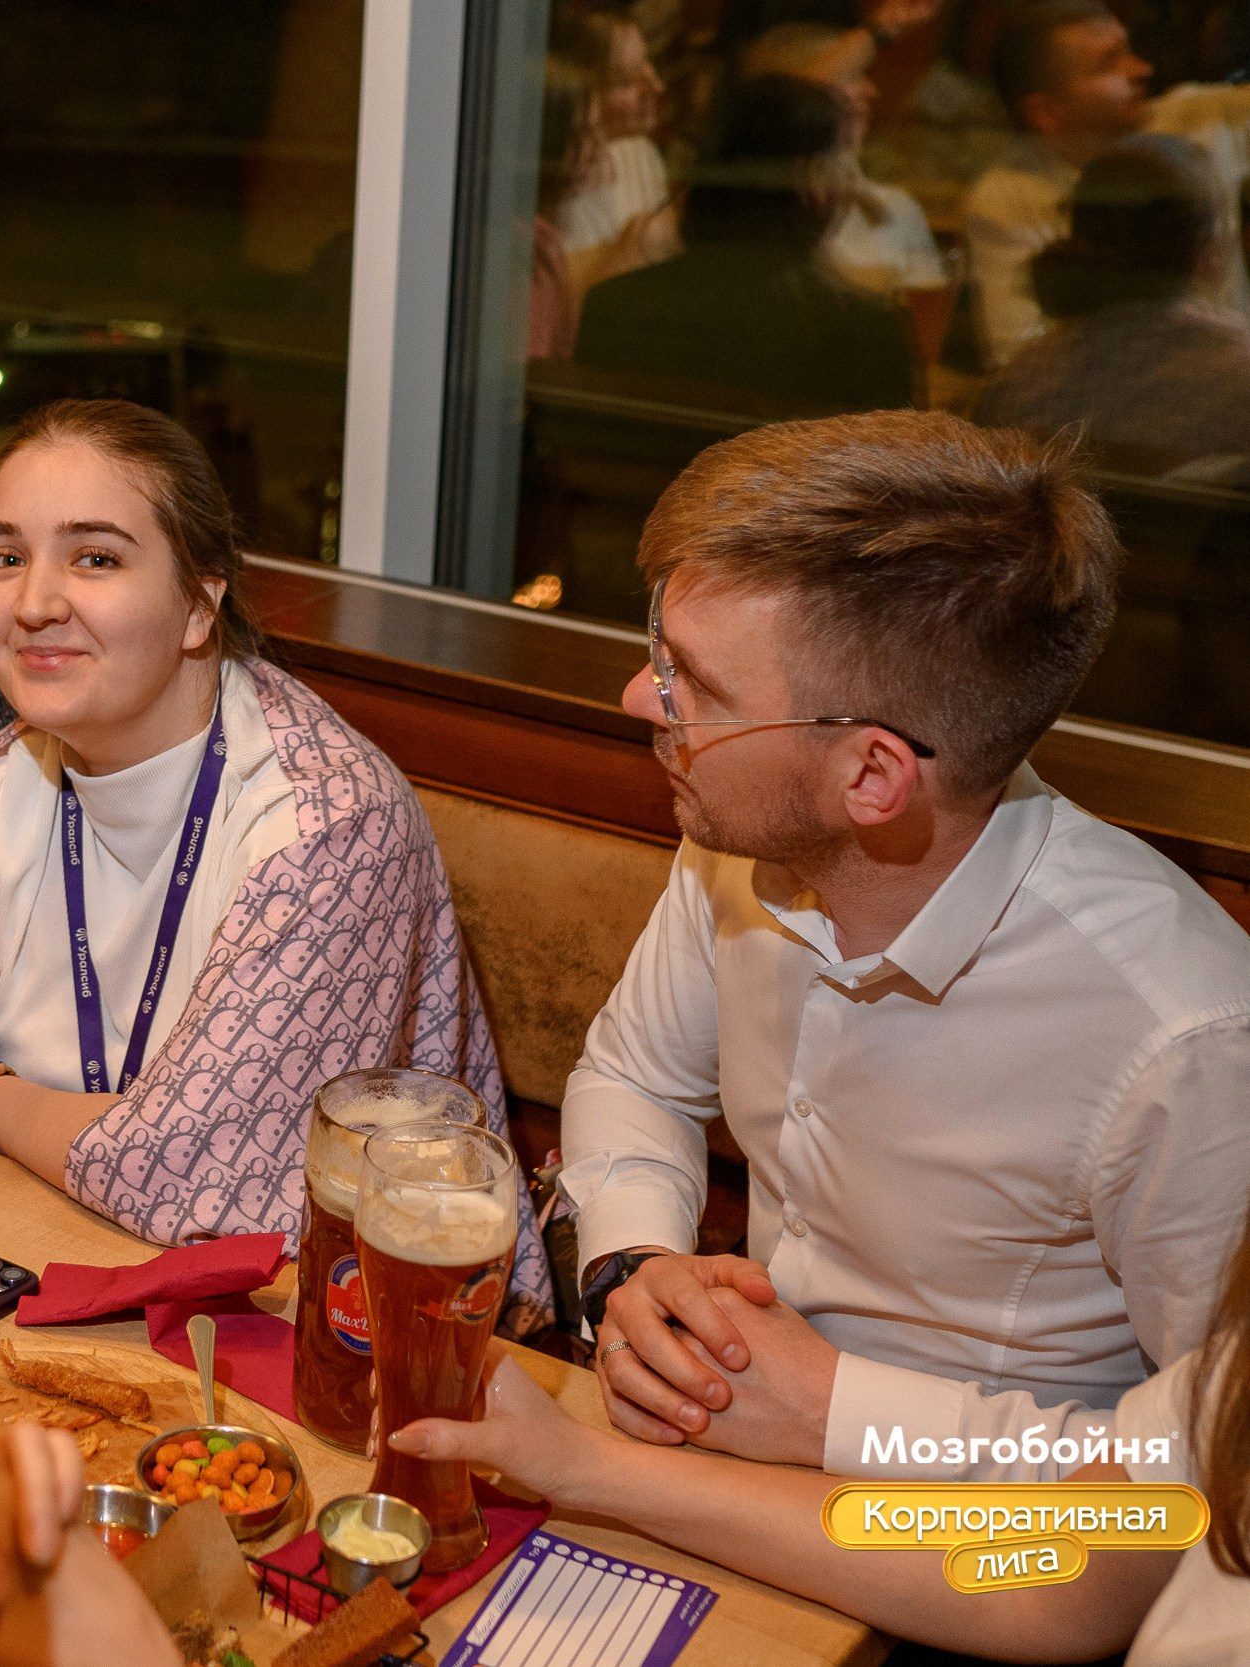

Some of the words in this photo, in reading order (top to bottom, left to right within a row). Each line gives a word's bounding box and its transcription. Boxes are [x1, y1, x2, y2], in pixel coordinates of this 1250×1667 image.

[67, 813, 80, 865] Уралсиб
[182, 816, 204, 868] Уралсиб
[77, 945, 91, 998] Уралсиб
[147, 945, 167, 996] Уралсиб
